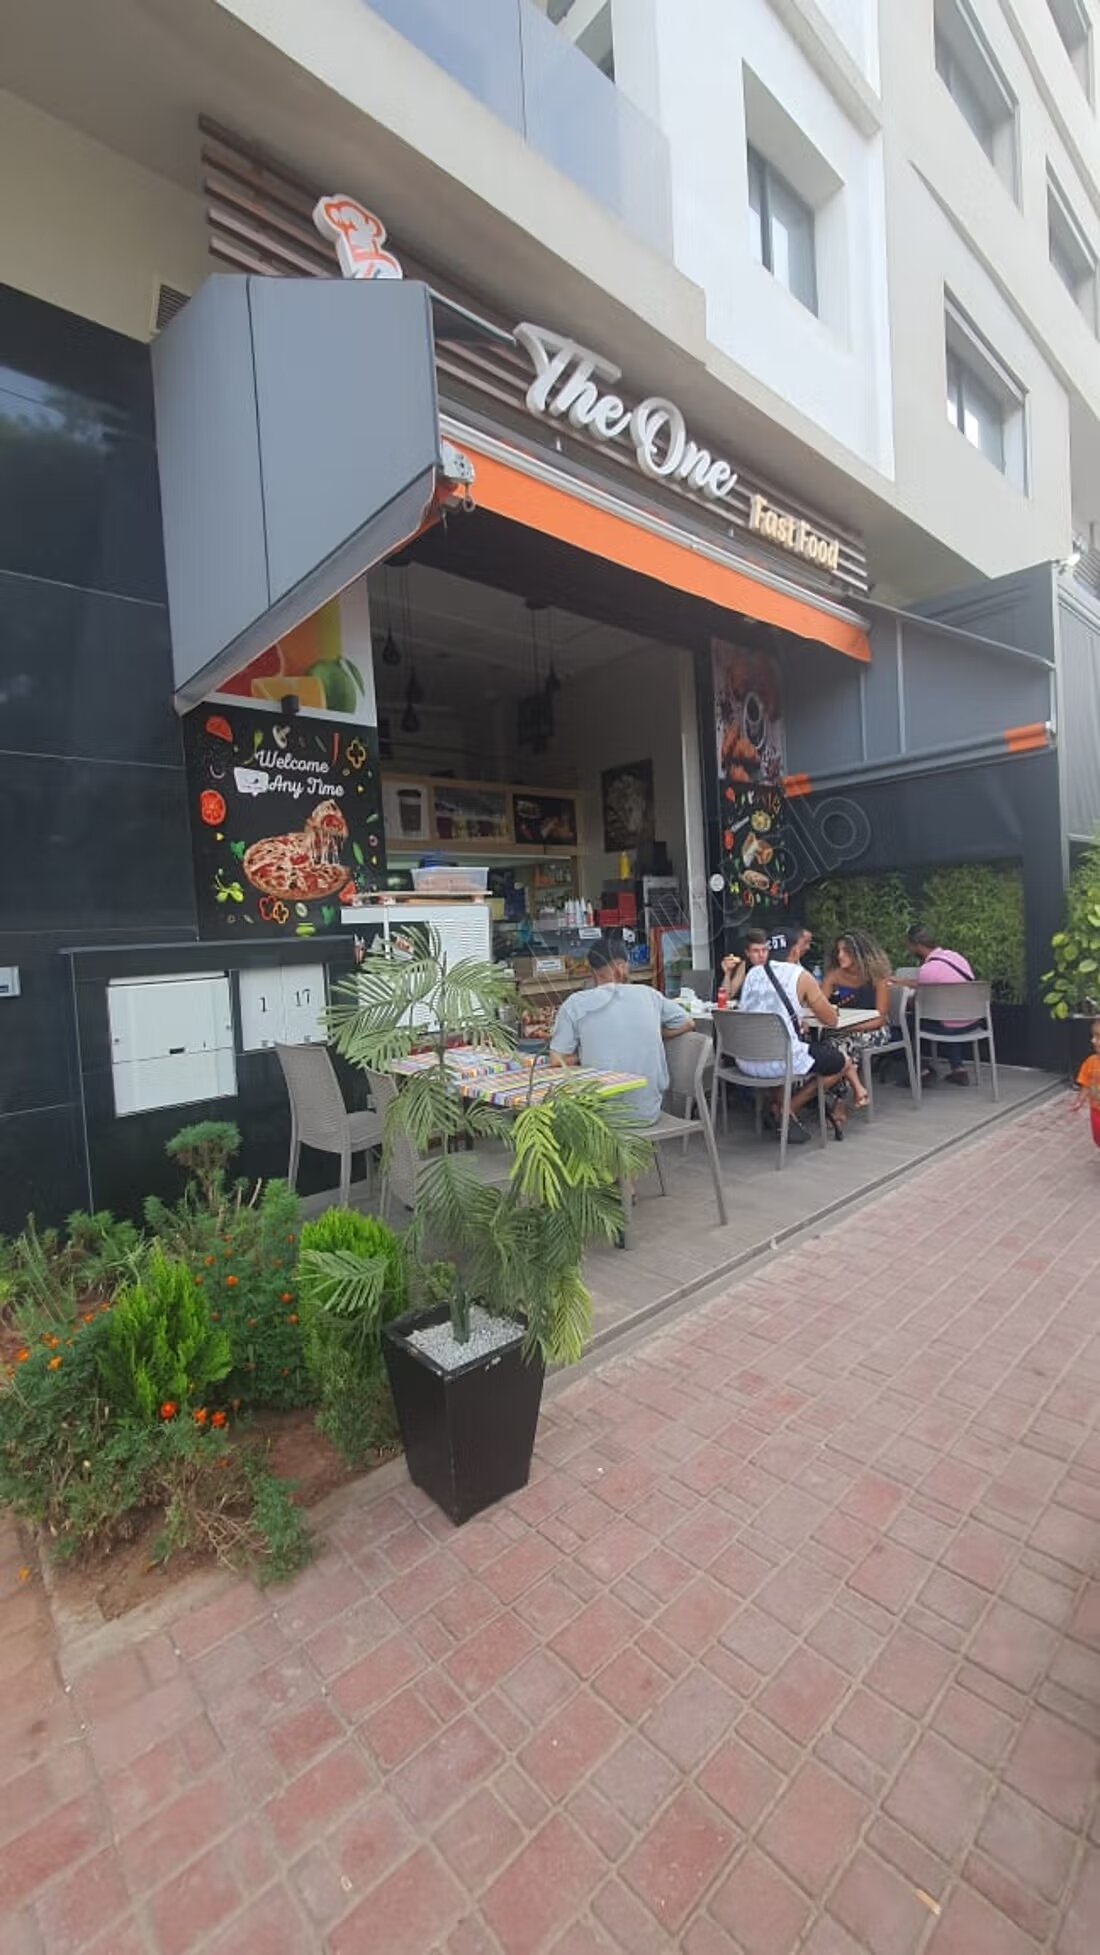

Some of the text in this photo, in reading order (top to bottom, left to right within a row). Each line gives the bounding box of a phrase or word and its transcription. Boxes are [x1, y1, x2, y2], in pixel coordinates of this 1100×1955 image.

[513, 321, 738, 500] The One
[749, 494, 840, 571] Fast Food
[254, 749, 330, 773] Welcome
[268, 774, 304, 799] Any
[306, 776, 344, 797] Time
[259, 996, 267, 1013] 1
[296, 988, 311, 1008] 17
